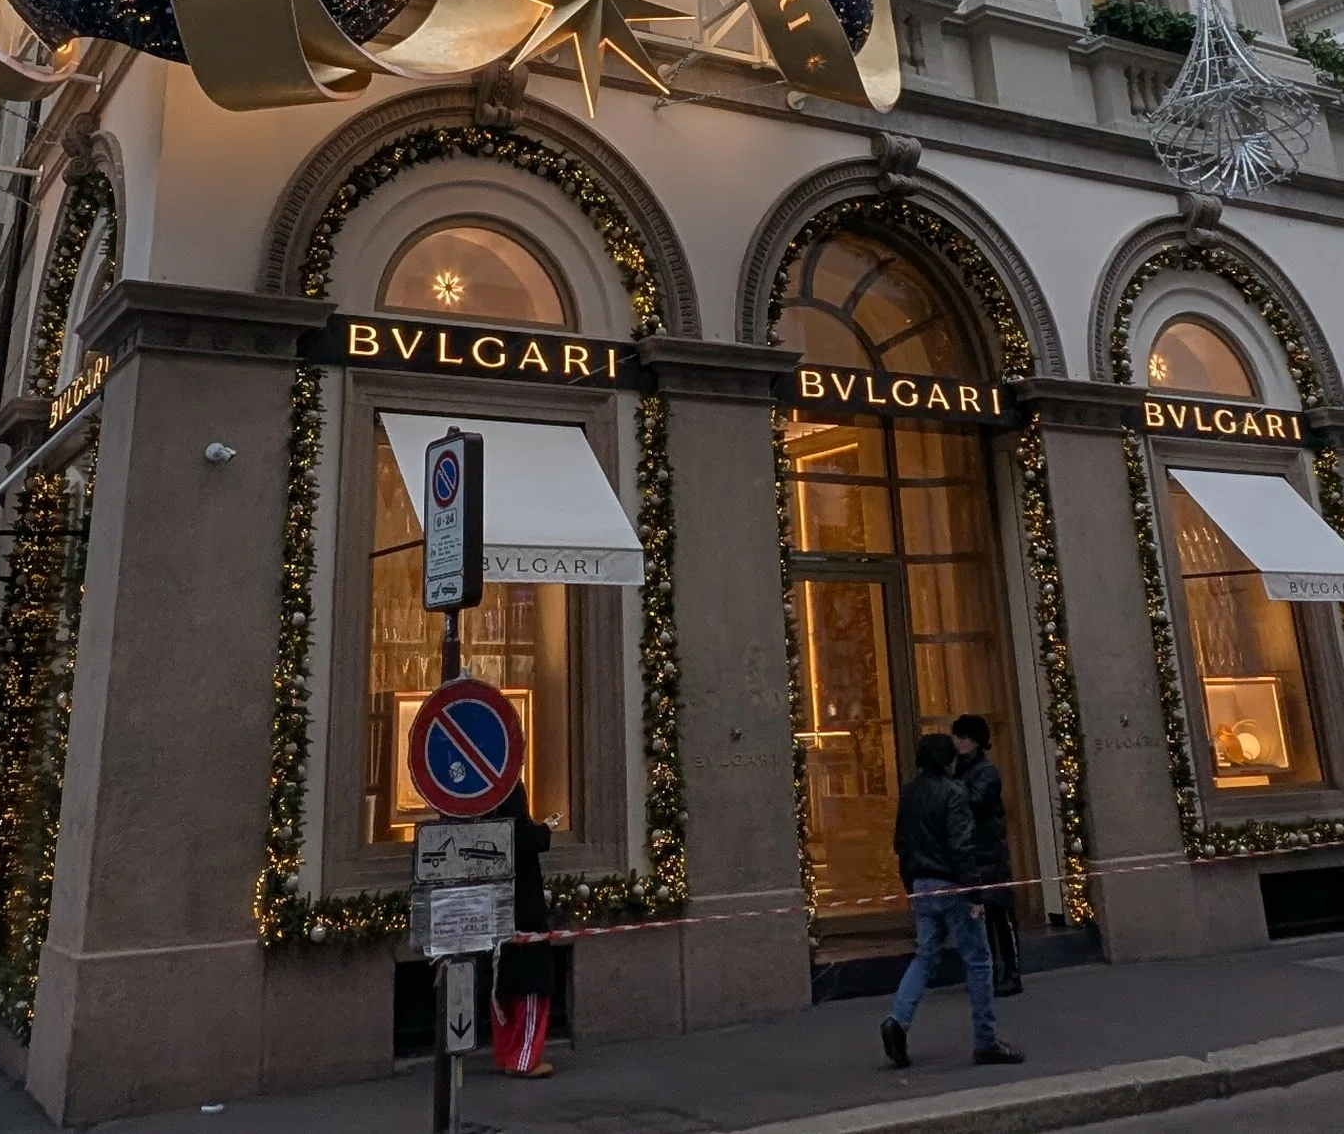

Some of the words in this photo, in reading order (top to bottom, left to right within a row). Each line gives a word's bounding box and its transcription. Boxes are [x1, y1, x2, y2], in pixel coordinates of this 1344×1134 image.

[348, 323, 617, 379] BVLGARI
[49, 355, 110, 430] BVLGARI
[800, 369, 1001, 415] BVLGARI
[1143, 401, 1302, 440] BVLGARI
